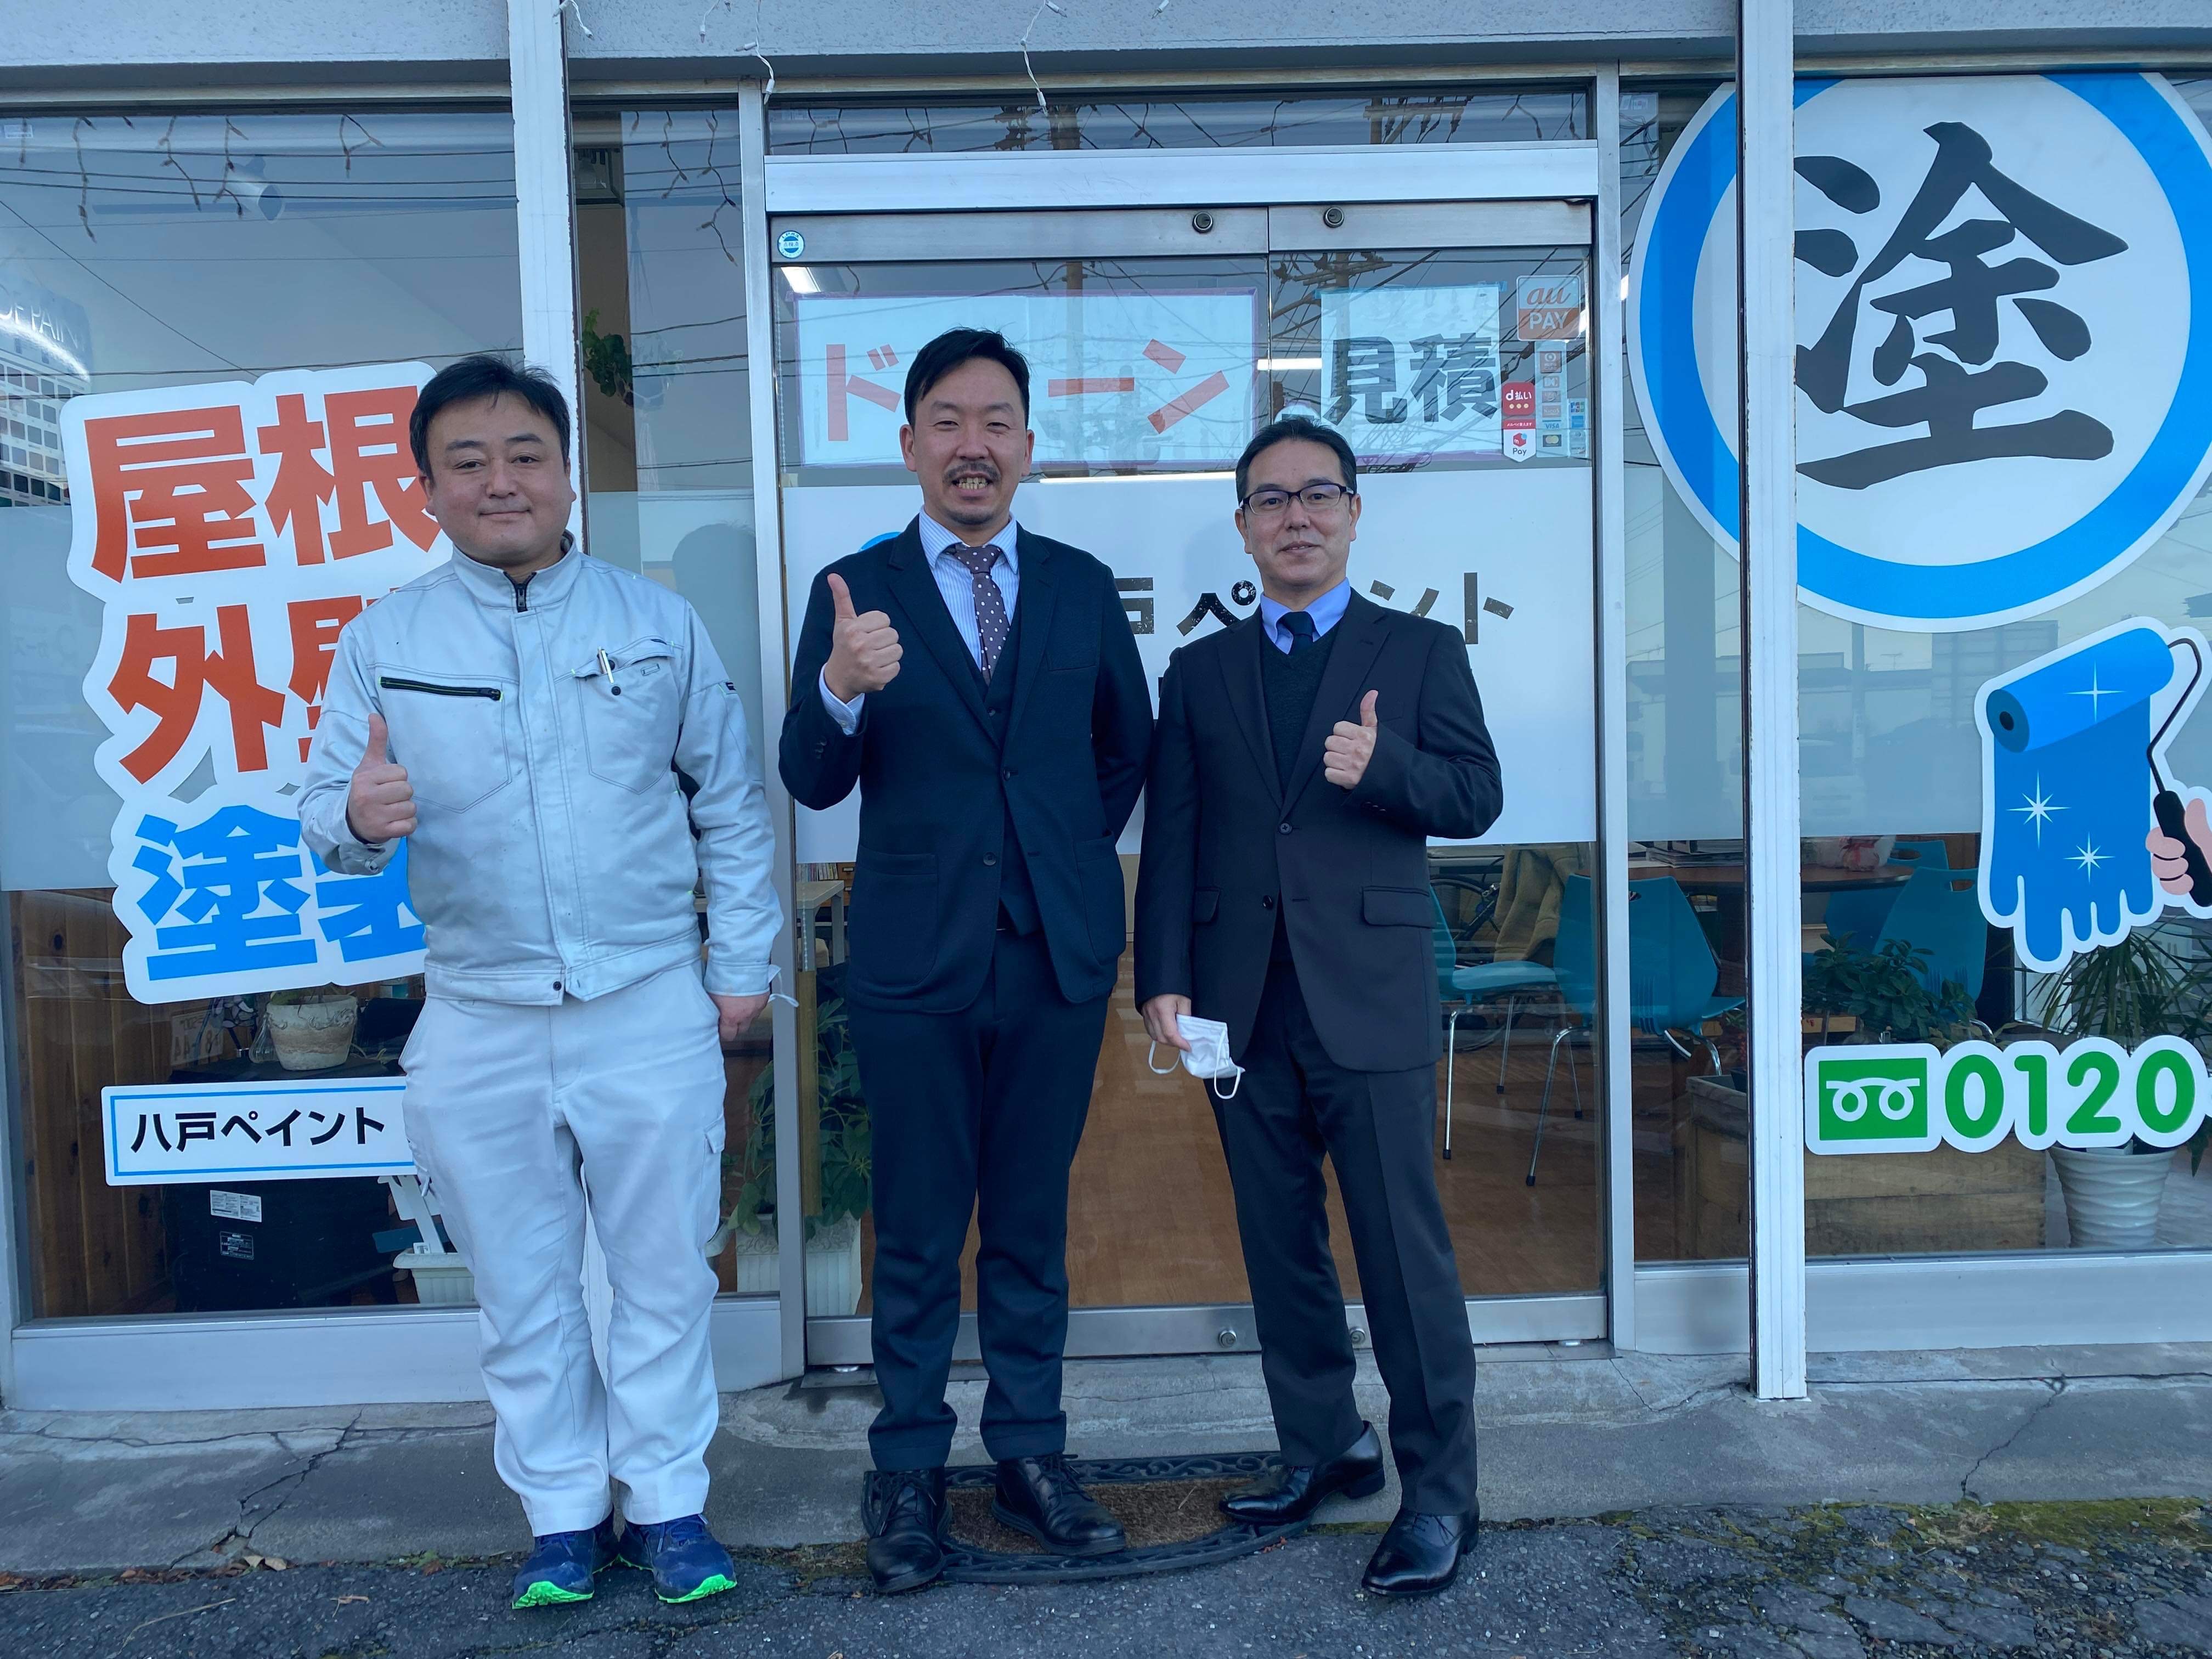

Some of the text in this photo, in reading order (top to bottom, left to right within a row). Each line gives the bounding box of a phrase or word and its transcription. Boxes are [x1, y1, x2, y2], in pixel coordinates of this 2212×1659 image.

[1527, 287, 1571, 305] au
[1530, 311, 1568, 329] PAY
[1794, 122, 2129, 489] 塗
[826, 338, 1230, 441] ドーン
[1322, 332, 1498, 426] 見積
[1505, 390, 1532, 401] d払い
[83, 385, 442, 584] 屋根
[1513, 448, 1527, 456] Pay
[106, 587, 400, 785] 外
[130, 1106, 385, 1153] 八戸ペイント
[1945, 1049, 2195, 1139] 0120
